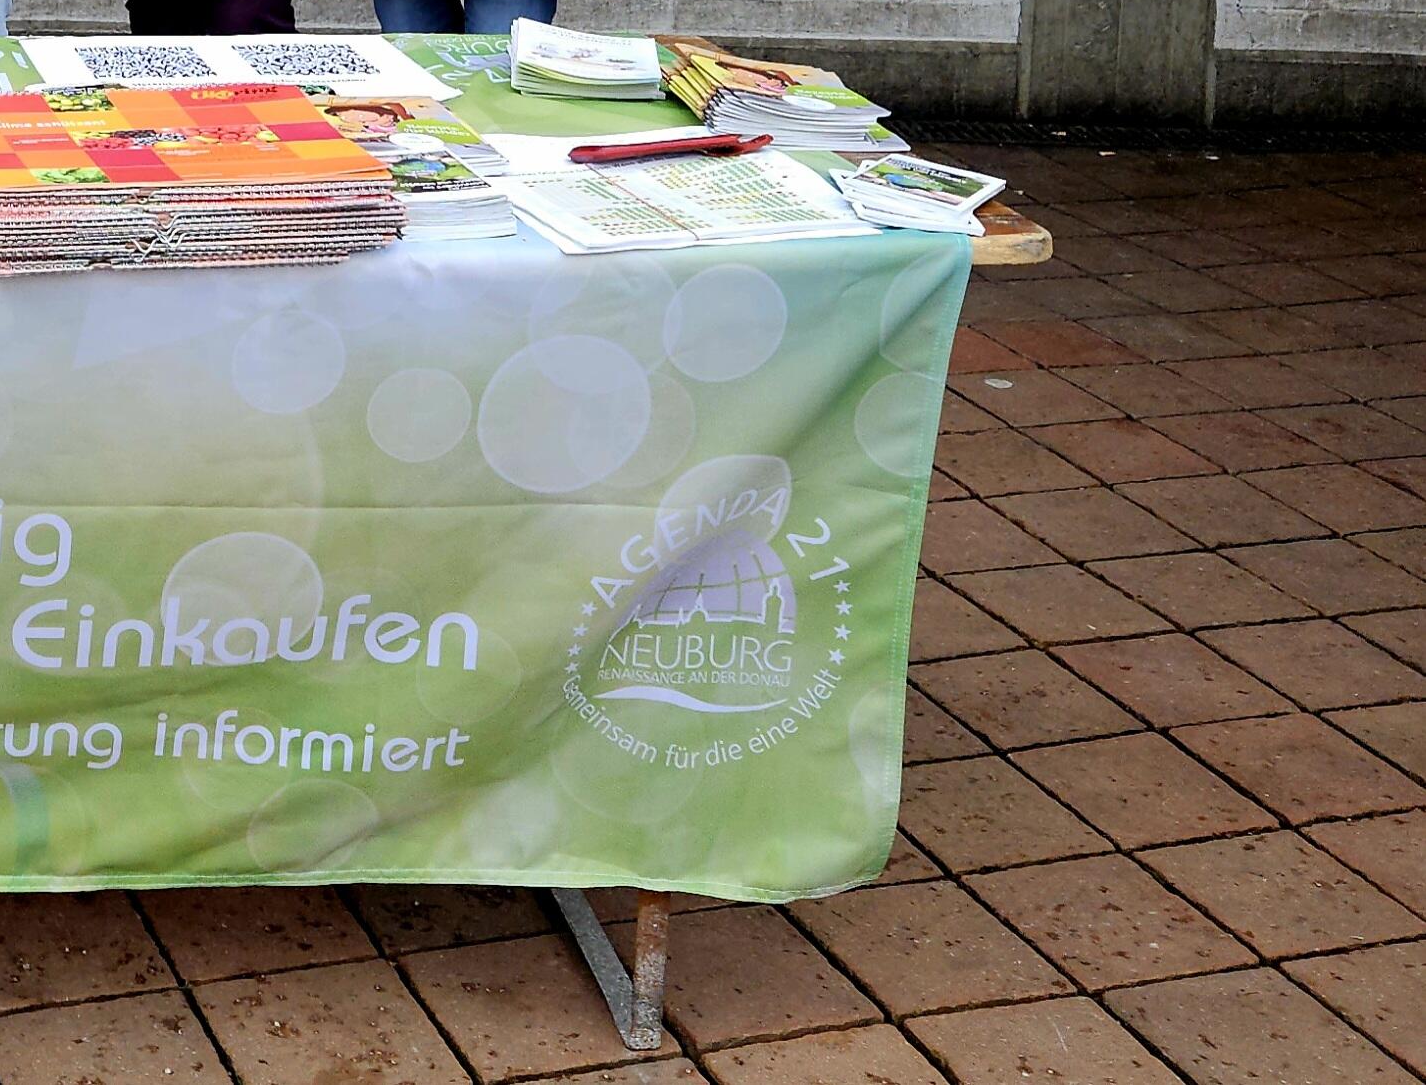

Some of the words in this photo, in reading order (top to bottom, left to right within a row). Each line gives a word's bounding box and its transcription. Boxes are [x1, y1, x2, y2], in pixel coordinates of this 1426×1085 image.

[590, 486, 789, 610] AGENDA
[786, 517, 851, 581] 21
[11, 594, 479, 671] Einkaufen
[599, 633, 794, 673] NEUBURG
[597, 667, 685, 685] RENAISSANCE
[688, 671, 708, 684] AN
[711, 671, 736, 684] DER
[739, 672, 791, 687] DONAU
[153, 710, 471, 773] informiert
[664, 743, 701, 769] für
[705, 739, 743, 767] die
[748, 717, 799, 755] eine
[789, 668, 842, 720] Welt
